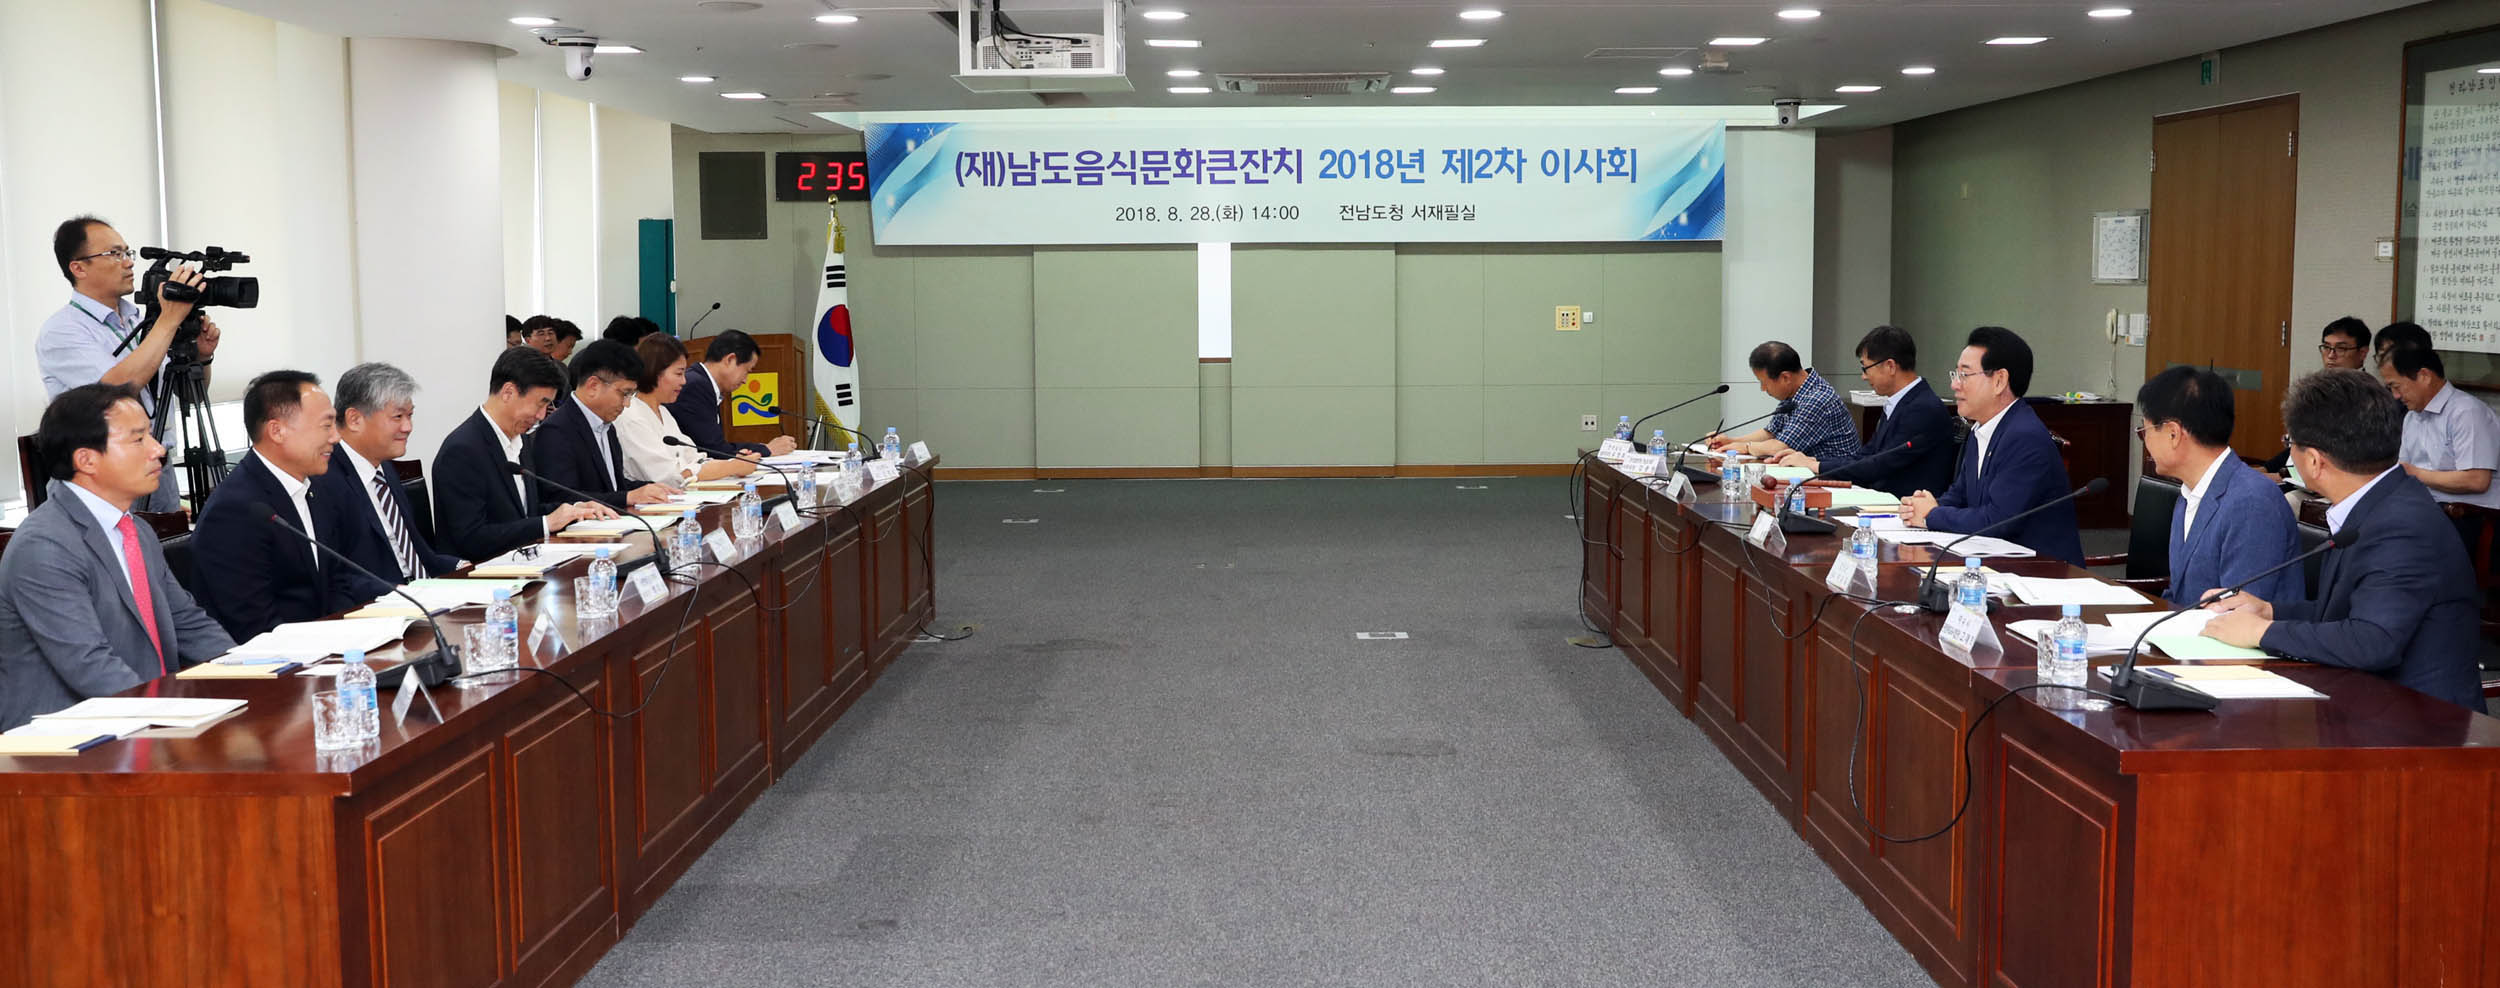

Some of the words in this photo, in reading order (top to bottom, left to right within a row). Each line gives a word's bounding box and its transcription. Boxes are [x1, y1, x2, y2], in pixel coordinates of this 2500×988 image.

[954, 147, 1304, 188] (재)남도음식문화큰잔치
[1318, 148, 1425, 184] 2018년
[1442, 146, 1528, 184] 제2차
[1541, 146, 1638, 184] 이사회
[1115, 206, 1161, 223] 2018.
[1167, 206, 1183, 222] 8.
[1190, 204, 1244, 223] 28.(화)
[1252, 205, 1300, 221] 14:00
[1339, 203, 1404, 222] 전남도청
[1410, 203, 1477, 222] 서재필실
